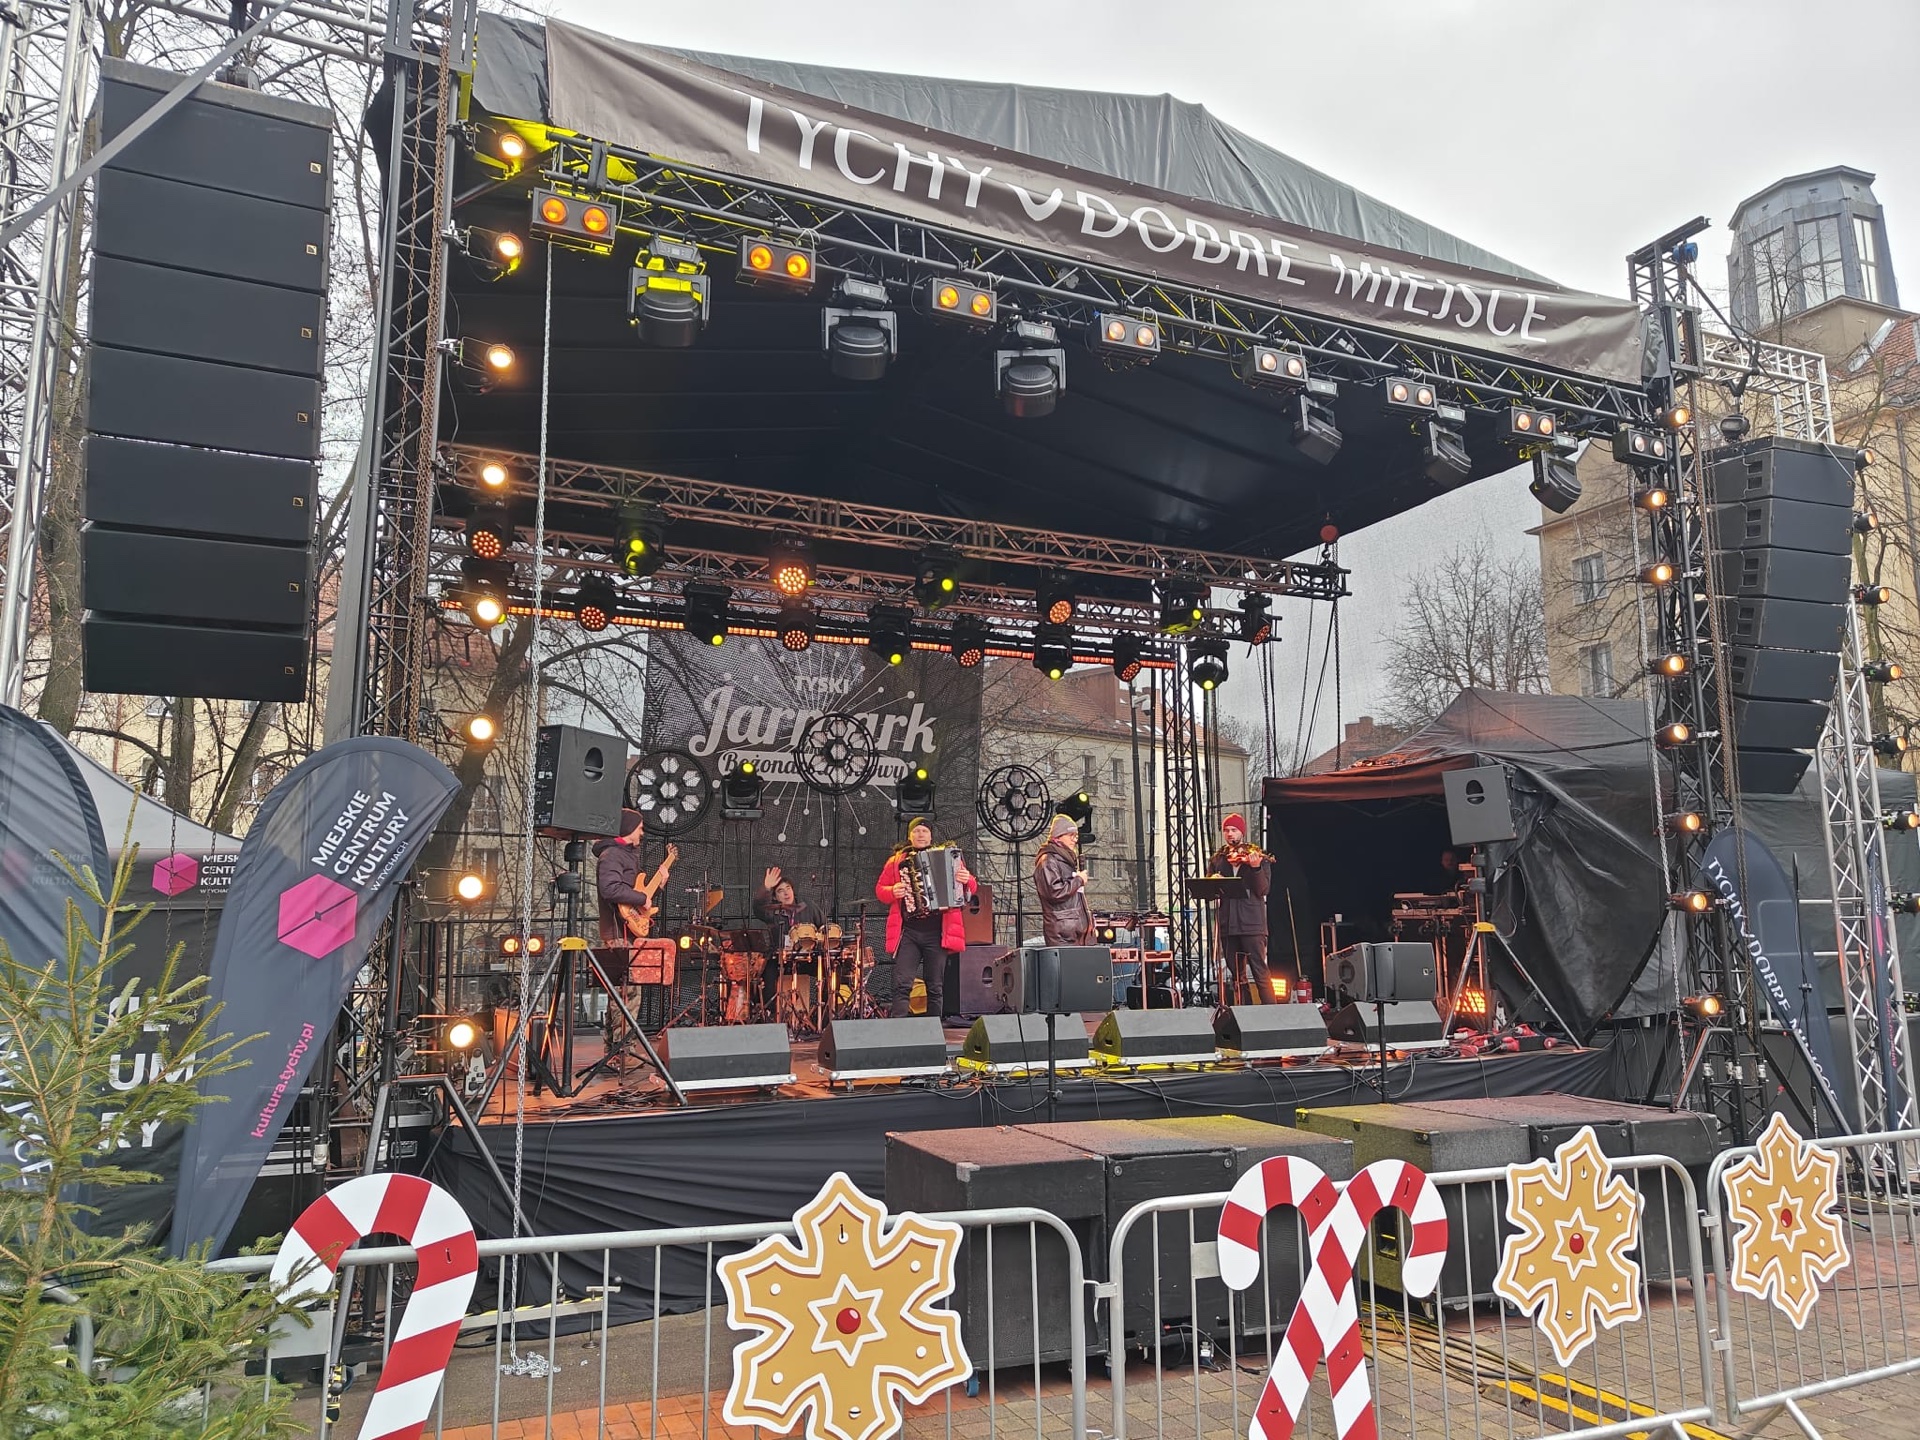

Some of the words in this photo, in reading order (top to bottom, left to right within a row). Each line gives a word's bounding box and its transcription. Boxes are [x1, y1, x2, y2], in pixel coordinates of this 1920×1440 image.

[734, 91, 992, 207] TYCHY
[1076, 190, 1305, 286] DOBRE
[1330, 254, 1549, 343] MIEJSCE
[794, 675, 850, 694] TYSKI
[311, 790, 371, 867] MIEJSKIE
[333, 791, 397, 875] CENTRUM
[351, 808, 409, 886] KULTURY
[370, 881, 381, 891] W
[378, 841, 409, 880] TYCHACH
[1708, 857, 1748, 919] TYCHY
[251, 1022, 315, 1138] kultura.tychy.pl
